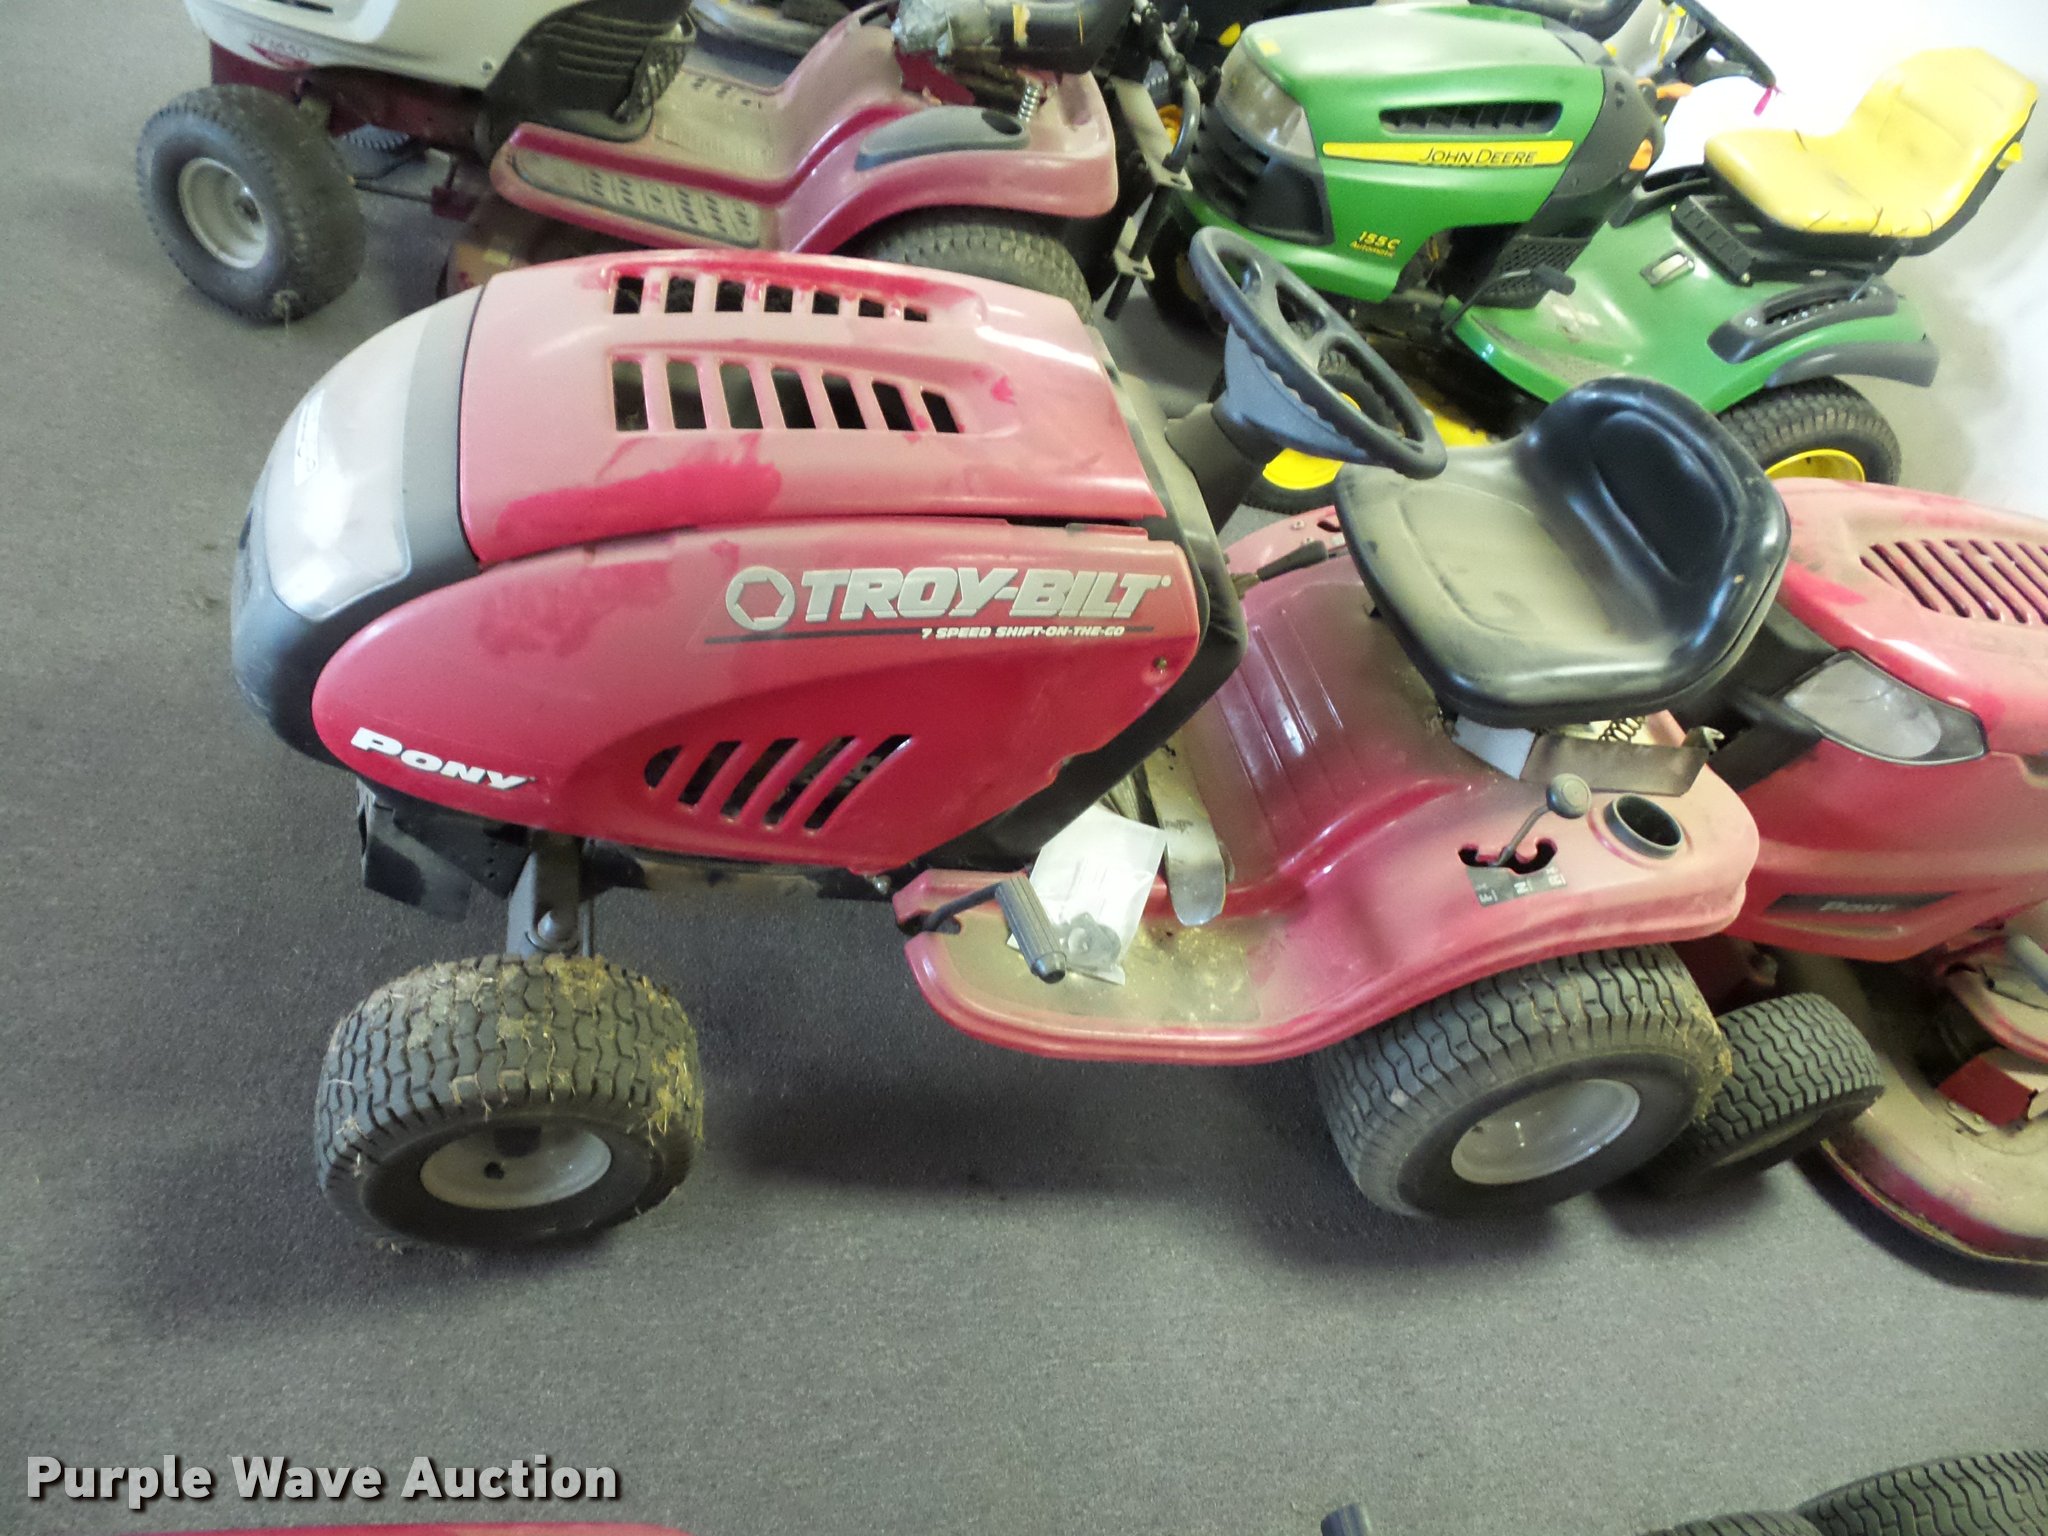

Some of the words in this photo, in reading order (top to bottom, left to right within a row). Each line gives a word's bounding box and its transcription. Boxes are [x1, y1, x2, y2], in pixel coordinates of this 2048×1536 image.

[1419, 147, 1473, 163] JOHN
[1475, 148, 1538, 164] DEERE
[801, 567, 1161, 621] TROY-BILT
[921, 627, 933, 639] 7
[935, 626, 992, 639] SPEED
[351, 726, 529, 790] PONY
